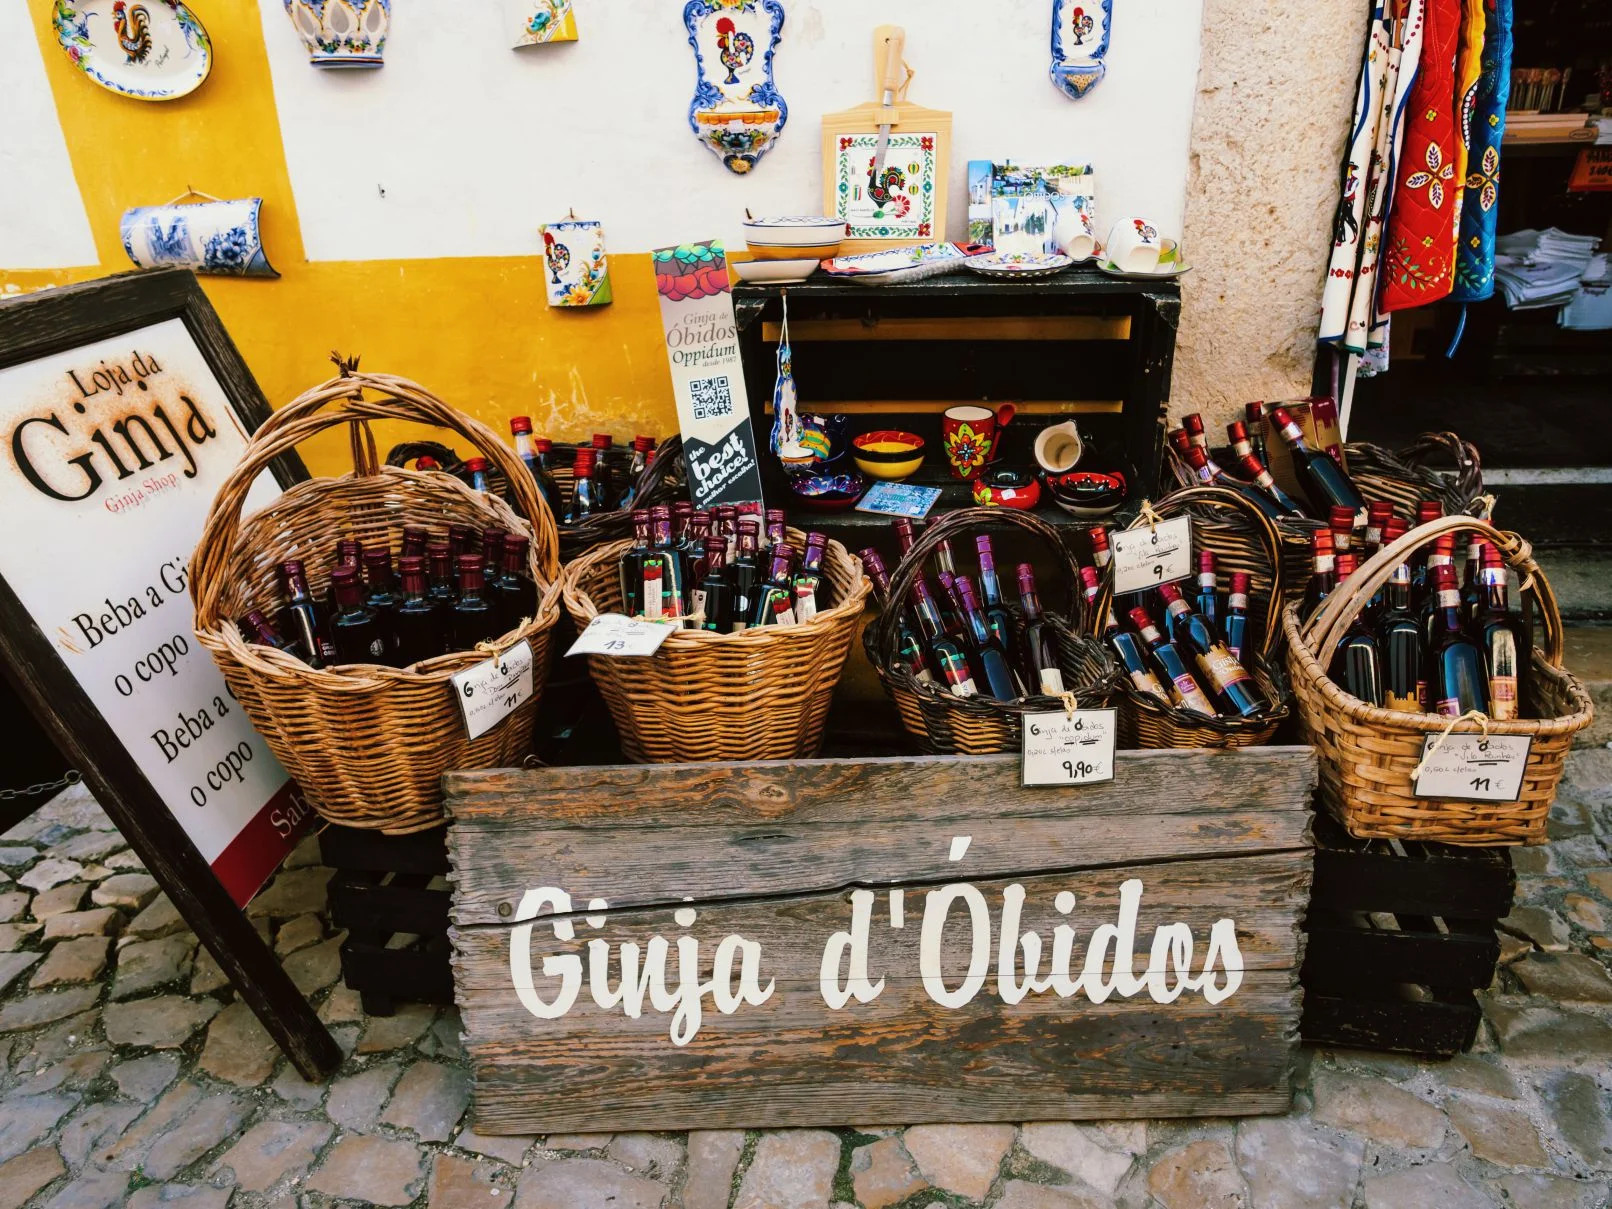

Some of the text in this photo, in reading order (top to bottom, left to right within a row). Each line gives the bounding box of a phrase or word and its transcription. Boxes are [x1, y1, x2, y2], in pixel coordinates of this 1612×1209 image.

[666, 322, 736, 349] Óbidos
[683, 310, 716, 326] Ginja
[66, 350, 163, 398] Loja da
[672, 342, 736, 367] Oppidum
[11, 380, 217, 502] Ginja
[688, 446, 706, 462] the
[691, 431, 744, 481] best
[105, 471, 178, 514] Ginja Shop
[695, 447, 749, 498] choice!
[702, 483, 727, 506] melhor
[1153, 564, 1163, 580] 9
[71, 556, 189, 649] Beba a Gi
[114, 633, 190, 697] o copo
[150, 695, 230, 765] Beba a
[190, 740, 253, 807] o copo
[270, 792, 311, 839] Sab
[509, 886, 776, 1046] Ginja
